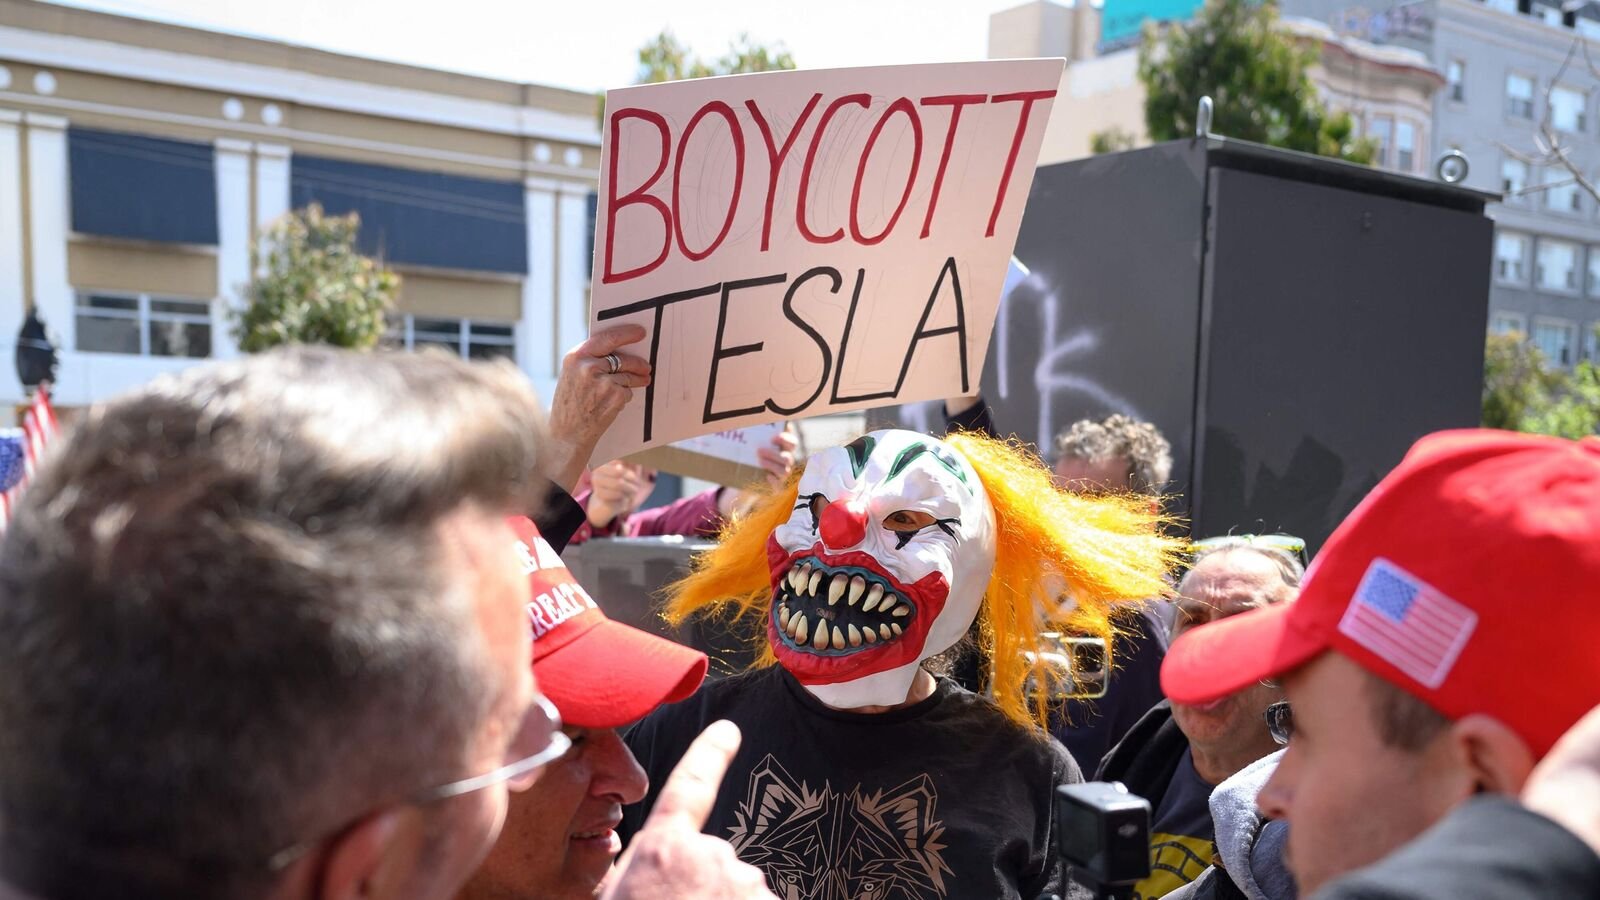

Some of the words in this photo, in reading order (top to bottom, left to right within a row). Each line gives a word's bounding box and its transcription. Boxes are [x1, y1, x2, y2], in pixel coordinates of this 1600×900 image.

[603, 90, 1057, 284] BOYCOTT
[597, 257, 969, 443] TESLA
[524, 583, 585, 641] REAT
